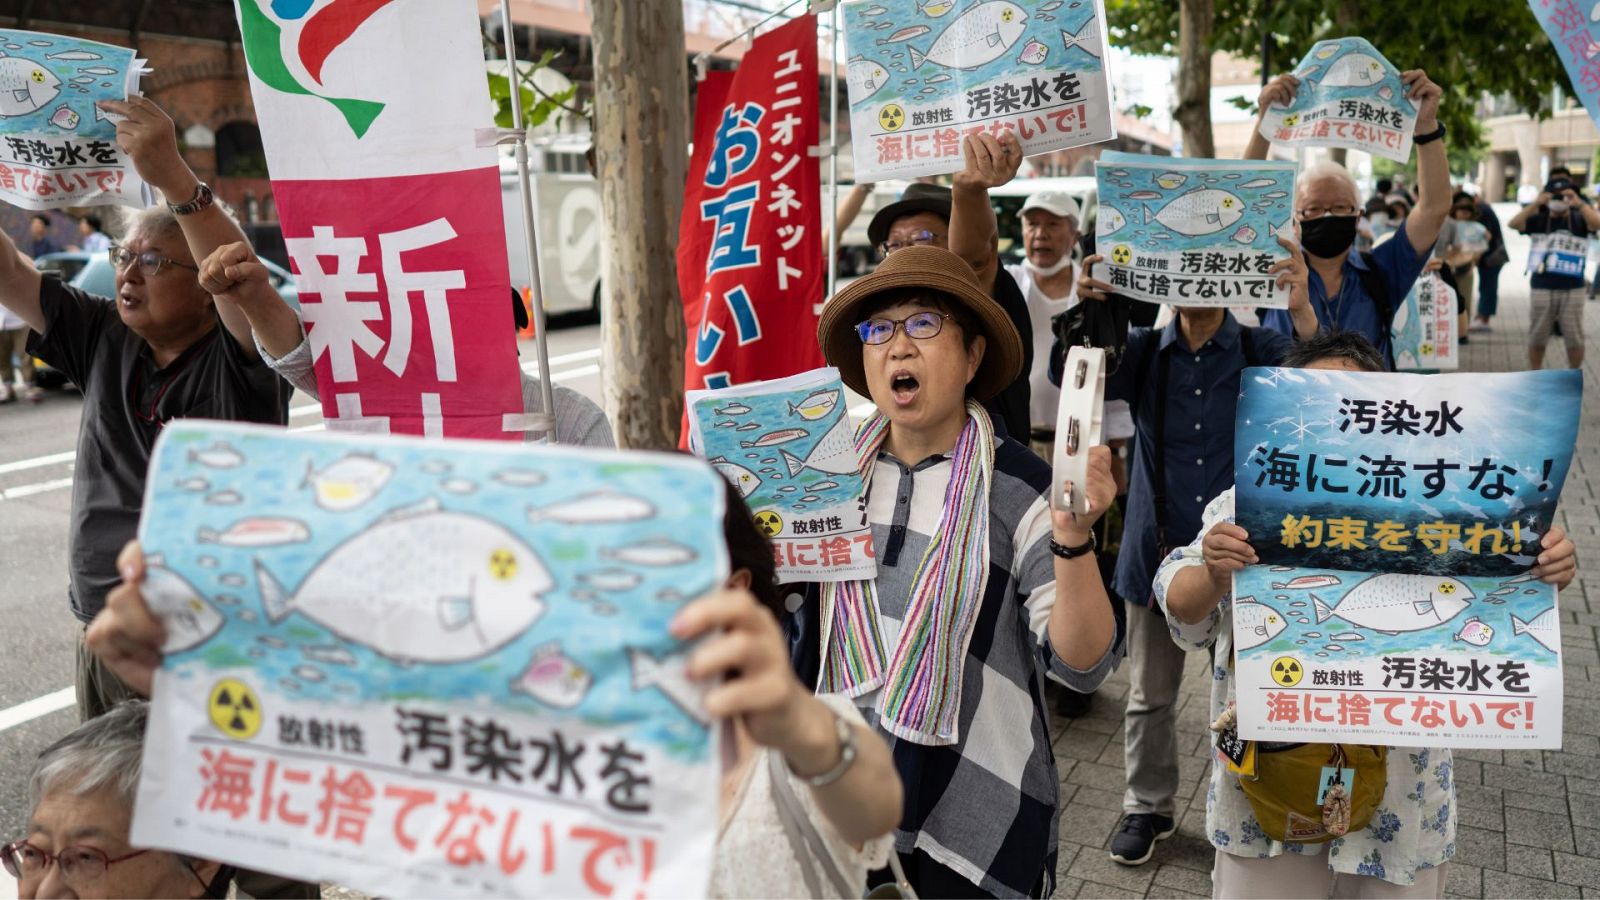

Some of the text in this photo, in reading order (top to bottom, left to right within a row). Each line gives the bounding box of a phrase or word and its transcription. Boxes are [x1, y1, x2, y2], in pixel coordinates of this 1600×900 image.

[912, 72, 1081, 125] 放射性 汚染水を
[1338, 99, 1403, 128] 汚染水を
[5, 136, 118, 166] 汚染水を
[767, 49, 806, 291] ユニオンネット
[1108, 266, 1275, 298] 海に捨てないで!
[1135, 251, 1276, 274] 放射能 汚染水を
[1338, 397, 1464, 437] 汚染水
[1254, 446, 1554, 500] 海に流すな！
[791, 515, 843, 534] 放射性
[1280, 513, 1522, 555] 約束を守れ!
[1312, 656, 1531, 693] 放射性 汚染水を
[1265, 692, 1535, 730] 海に捨てないで!
[277, 706, 653, 816] 放射性 汚染水を
[195, 747, 657, 900] 海に捨てないで!
